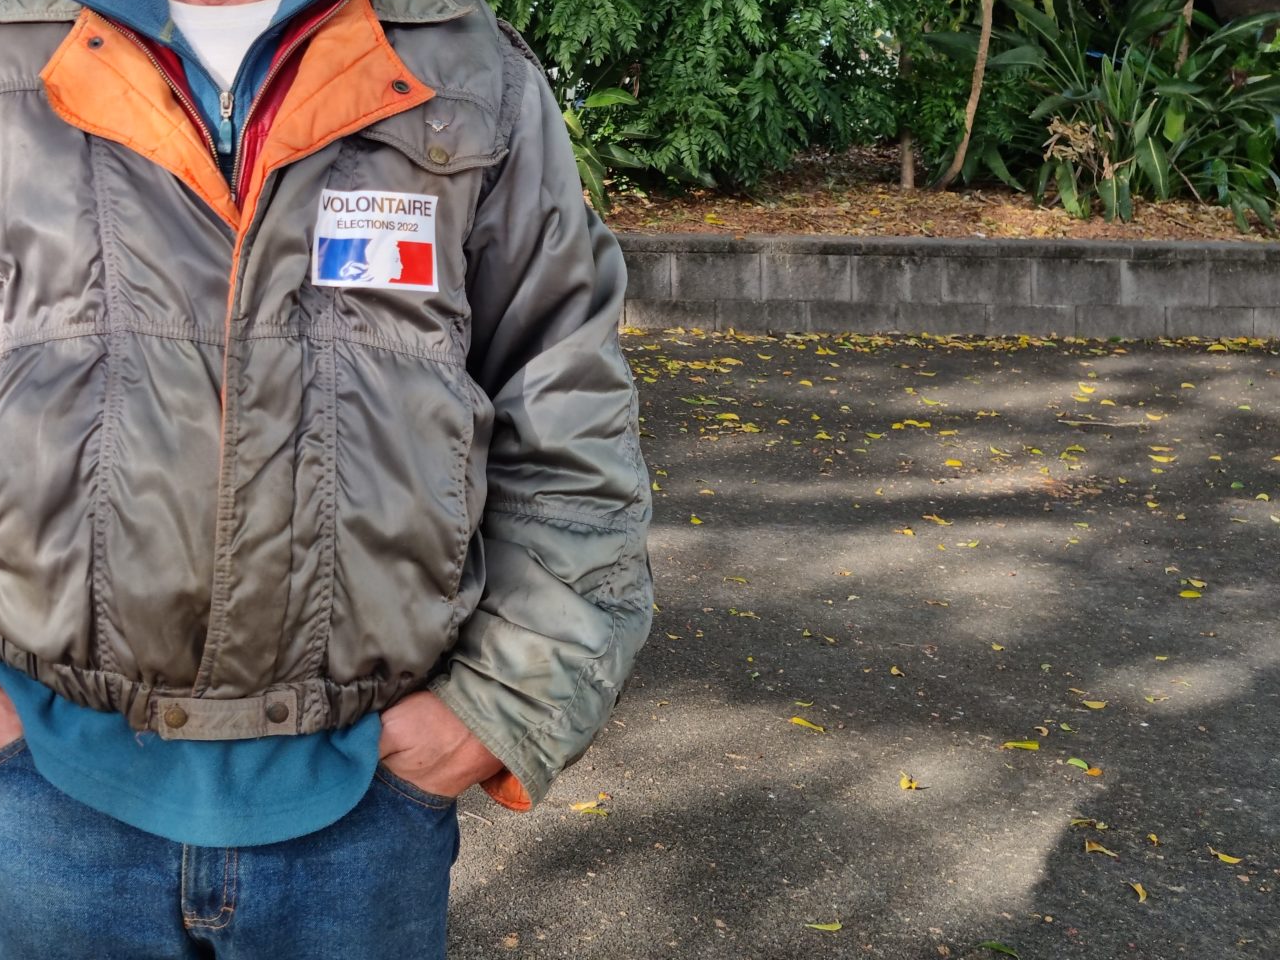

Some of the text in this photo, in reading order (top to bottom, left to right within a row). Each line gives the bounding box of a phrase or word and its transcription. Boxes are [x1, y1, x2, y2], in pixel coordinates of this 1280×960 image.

[323, 196, 432, 217] VOLONTAIRE
[337, 218, 419, 232] ÉLECTIONS 2022
